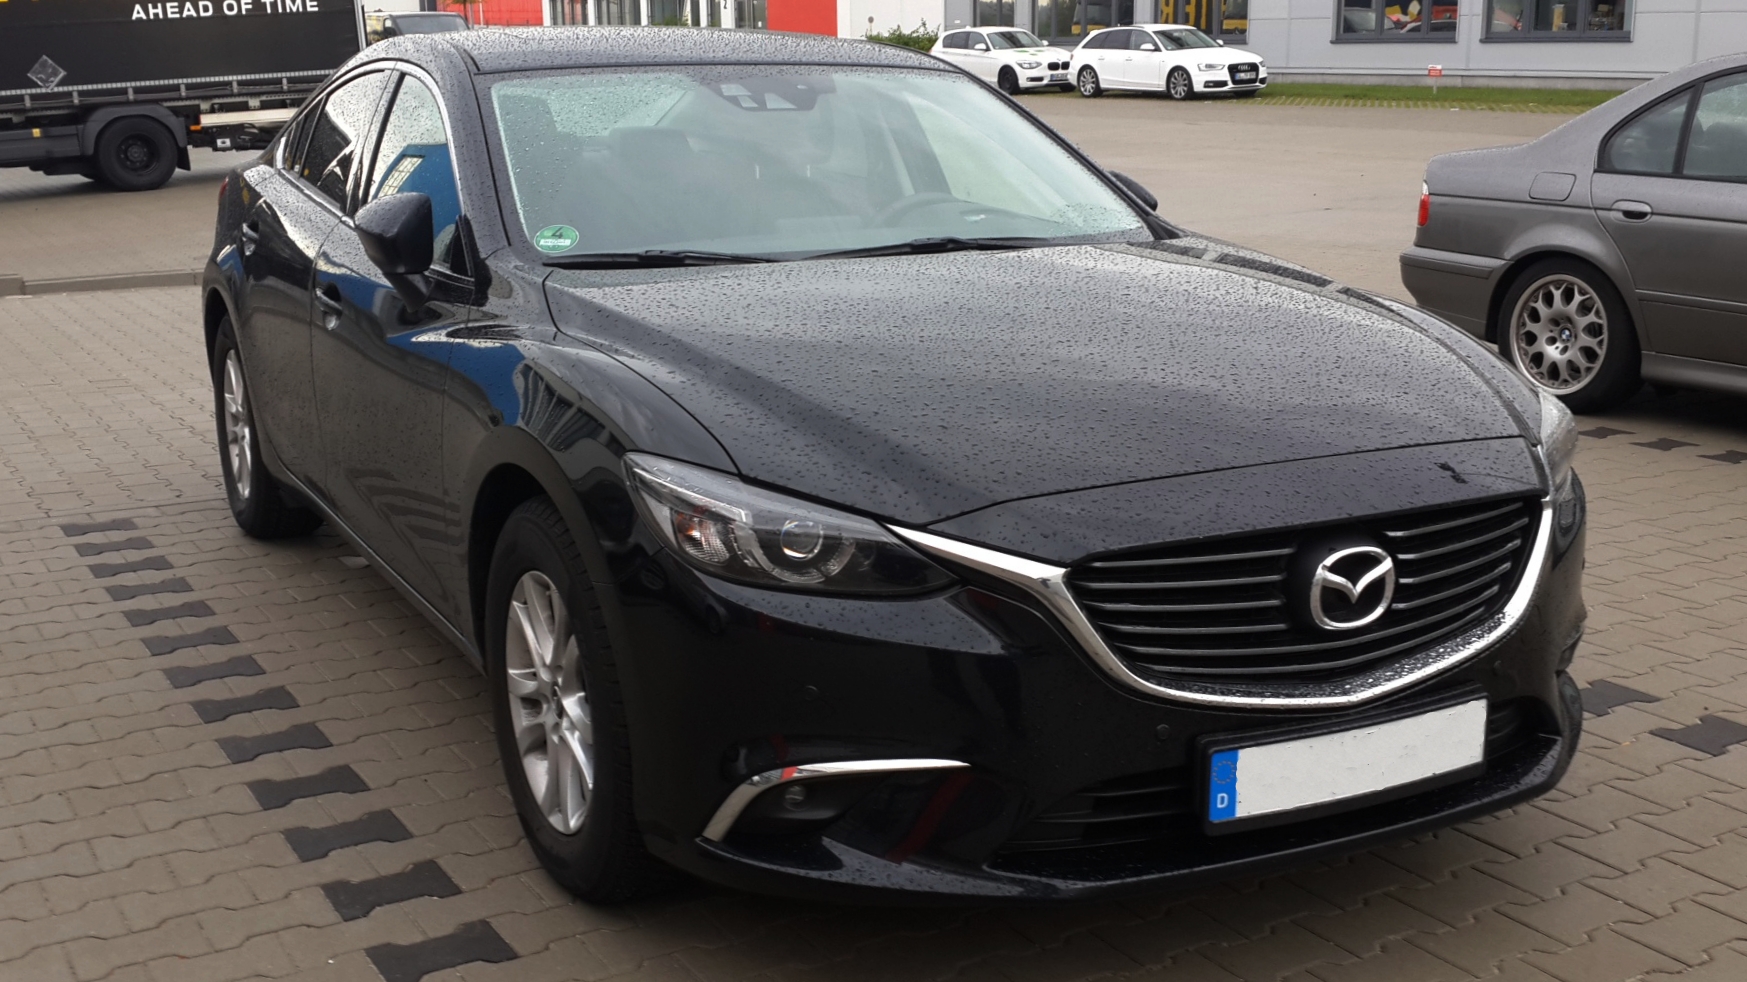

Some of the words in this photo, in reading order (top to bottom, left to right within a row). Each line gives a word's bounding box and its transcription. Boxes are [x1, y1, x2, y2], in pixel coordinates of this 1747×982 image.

[131, 1, 214, 20] AHEAD
[222, 0, 253, 16] OF
[261, 0, 319, 13] TIME
[551, 226, 564, 239] 4
[1217, 793, 1229, 808] D
